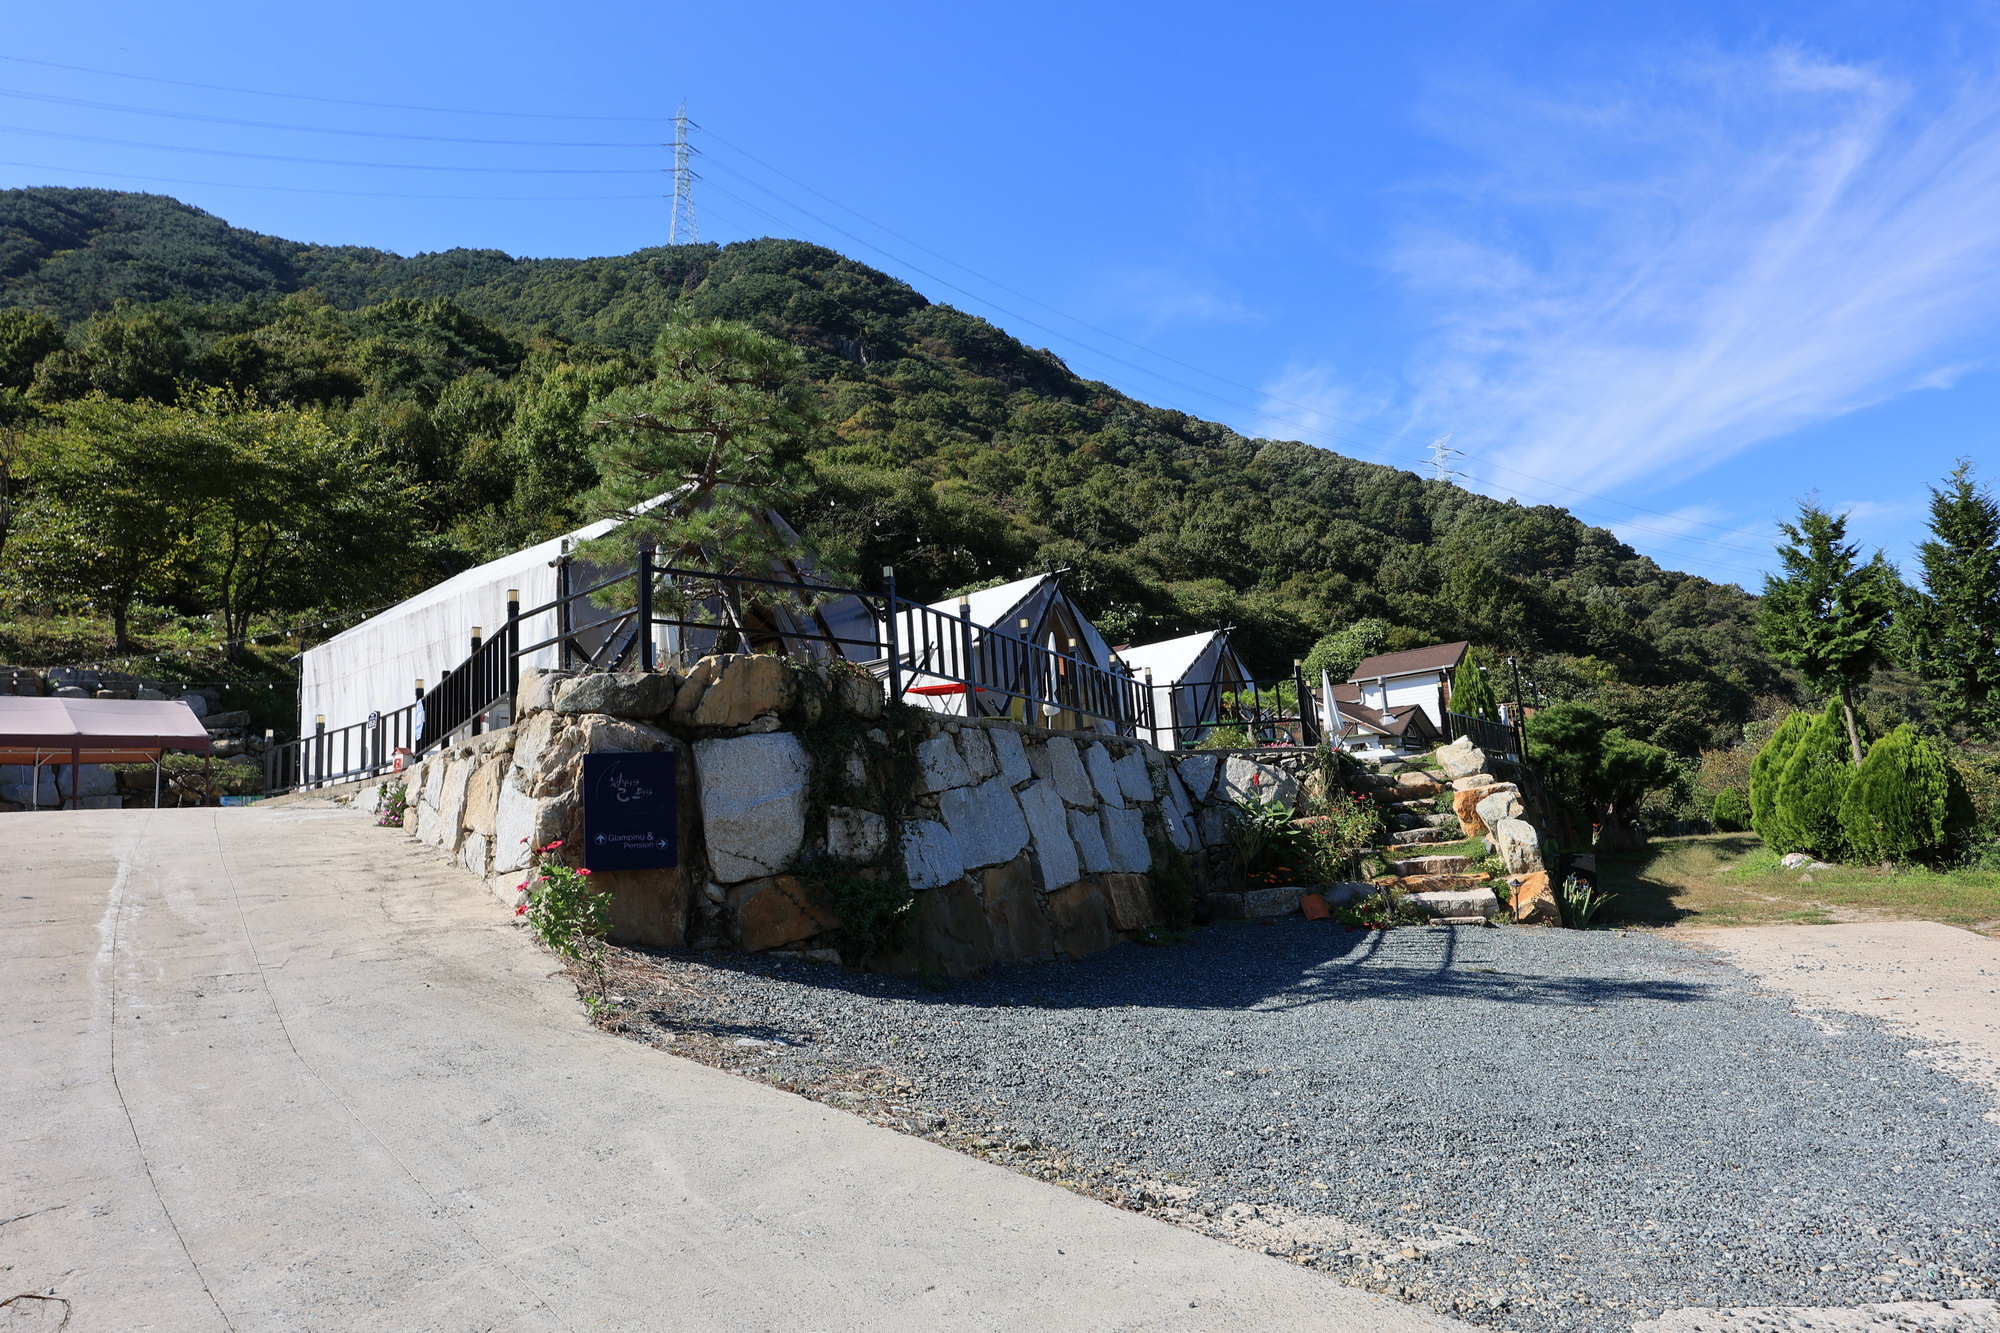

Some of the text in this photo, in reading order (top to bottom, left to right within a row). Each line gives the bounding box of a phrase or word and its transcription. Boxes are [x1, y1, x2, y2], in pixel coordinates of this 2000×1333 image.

[607, 831, 655, 842] Glamping &
[623, 841, 654, 849] Pension
